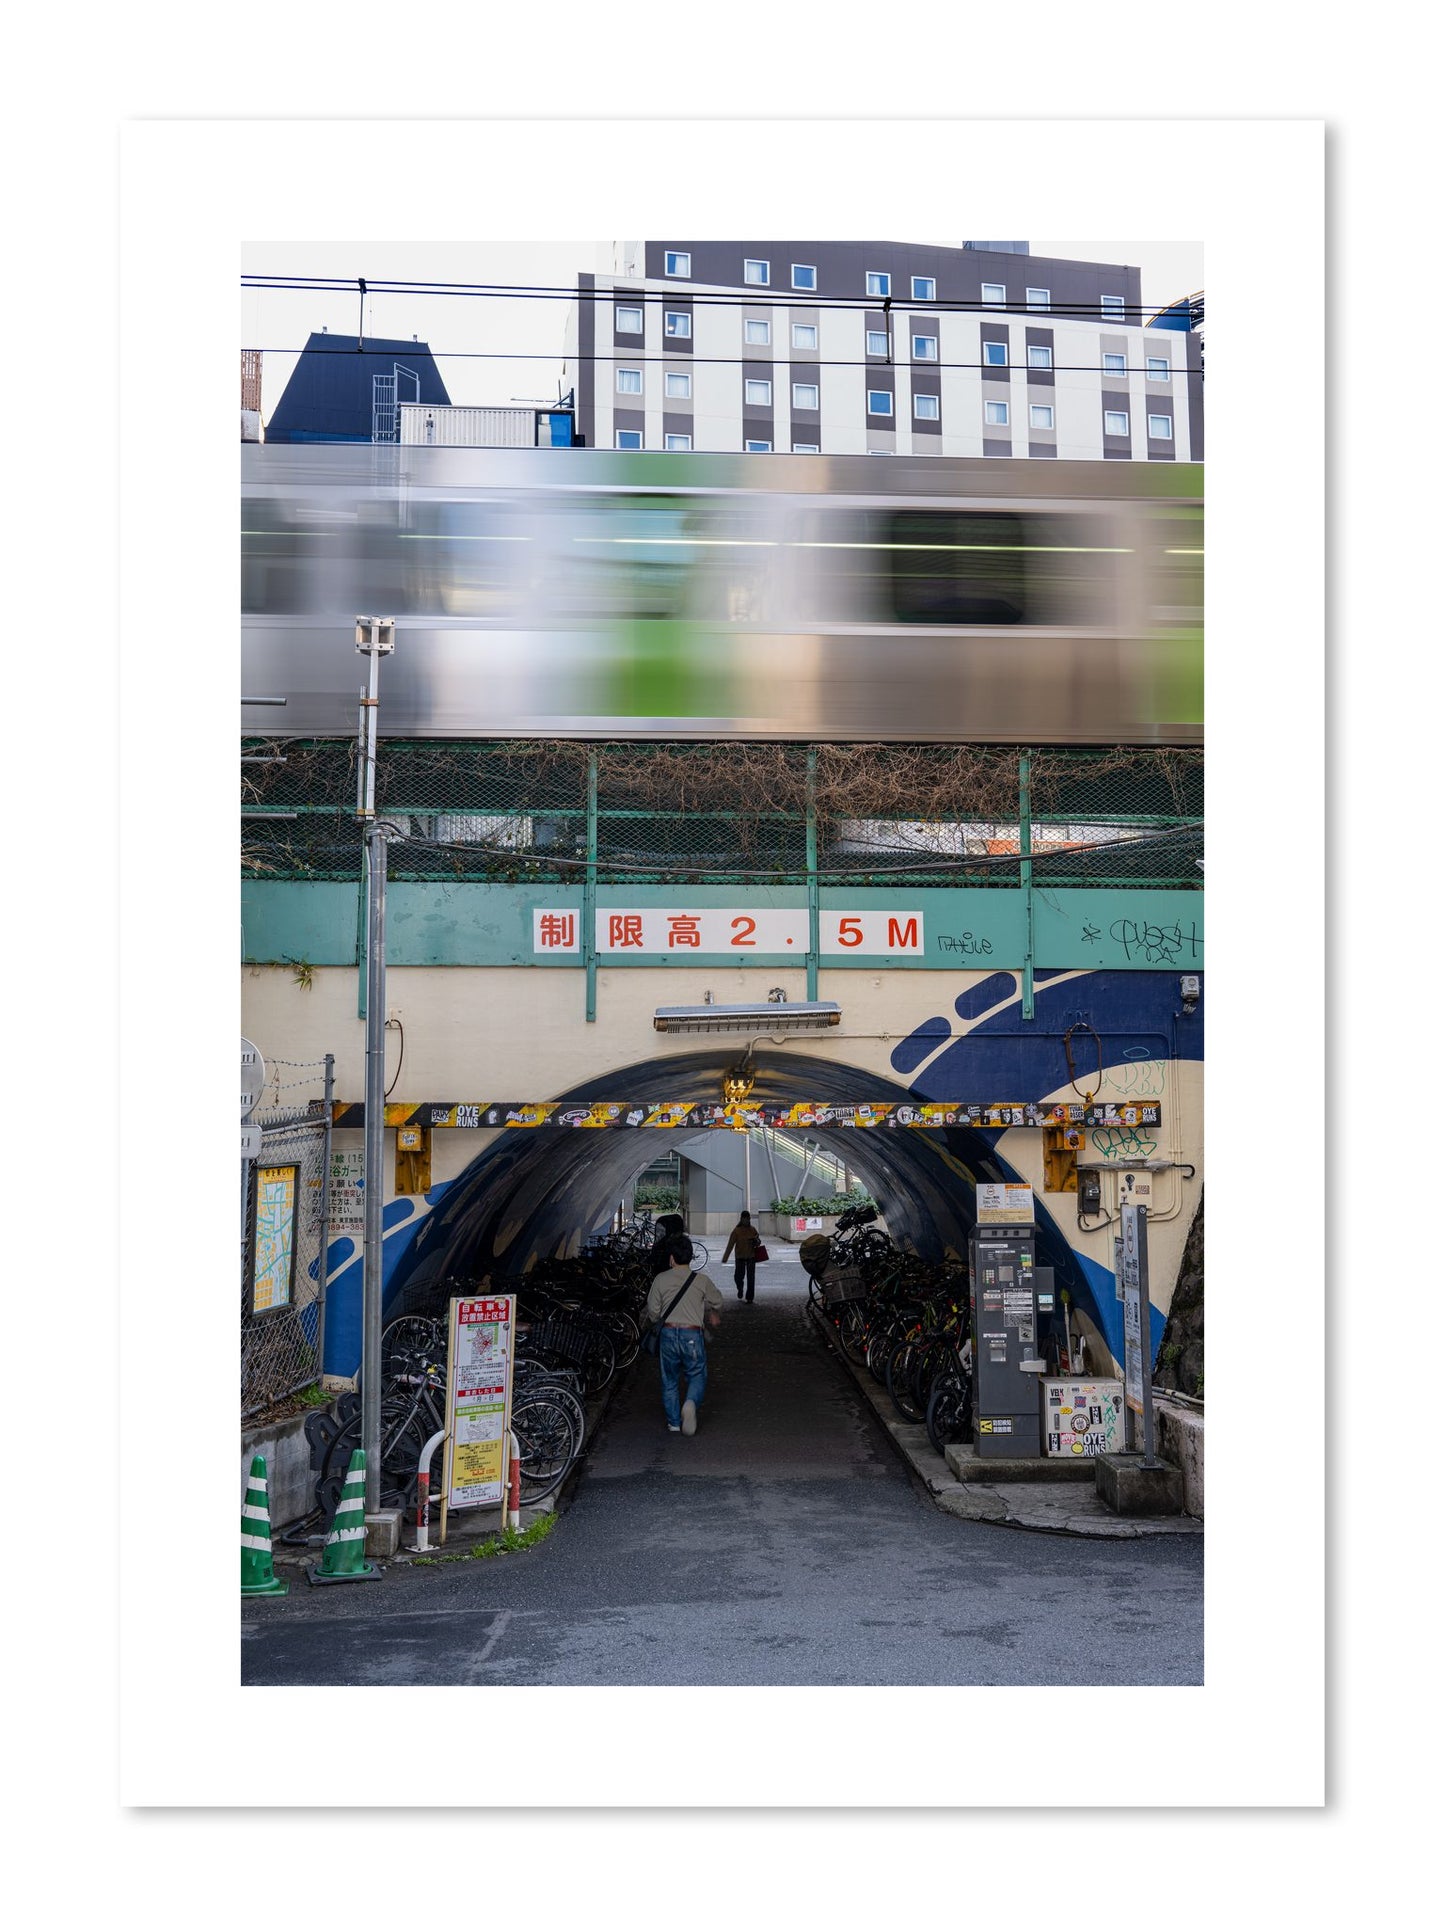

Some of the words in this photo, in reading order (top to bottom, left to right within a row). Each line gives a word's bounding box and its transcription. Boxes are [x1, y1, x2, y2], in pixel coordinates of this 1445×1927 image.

[457, 1105, 479, 1117] OYE
[456, 1116, 479, 1127] RUNS
[462, 1302, 507, 1313] 自転車等
[461, 1311, 506, 1322] 放置禁止区域
[1083, 1434, 1105, 1445] OYE
[1084, 1445, 1106, 1456] RUNS
